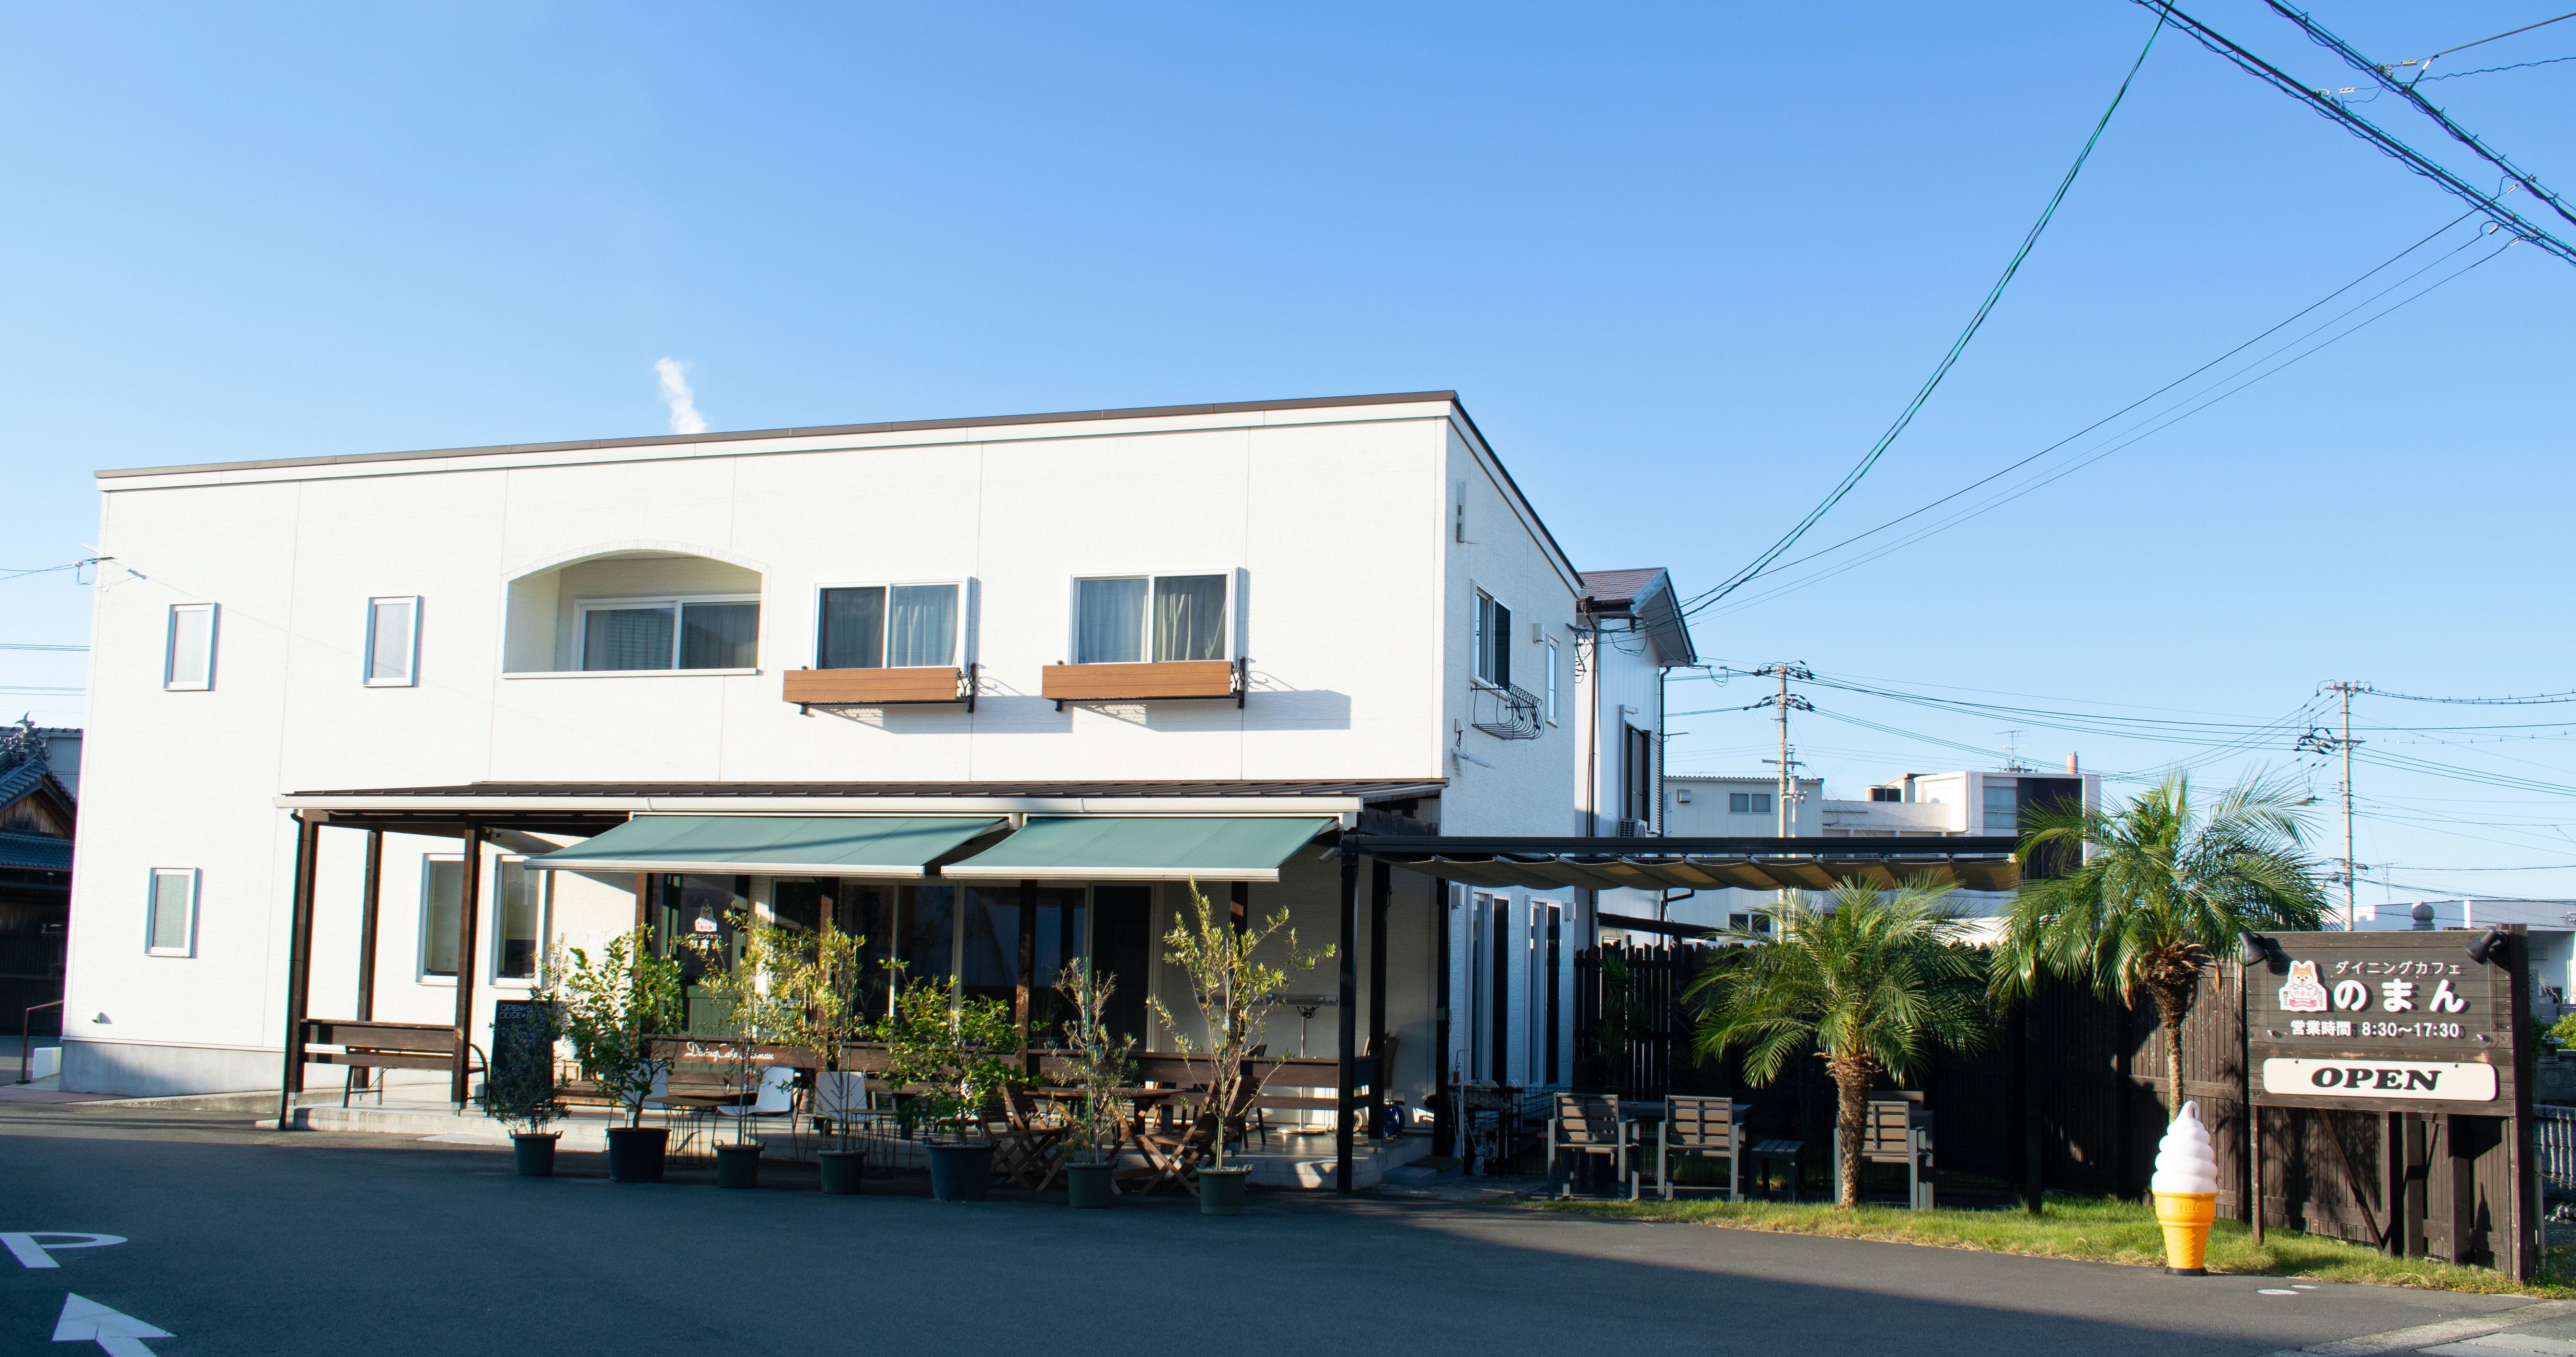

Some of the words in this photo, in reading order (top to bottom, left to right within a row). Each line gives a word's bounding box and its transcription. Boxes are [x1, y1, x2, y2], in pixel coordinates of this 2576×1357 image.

[2335, 960, 2460, 975] ダイニングカフェ
[2334, 978, 2464, 1012] のまん
[2290, 1020, 2351, 1036] 営業時間
[2311, 1068, 2442, 1091] OPEN
[0, 1232, 128, 1268] P
